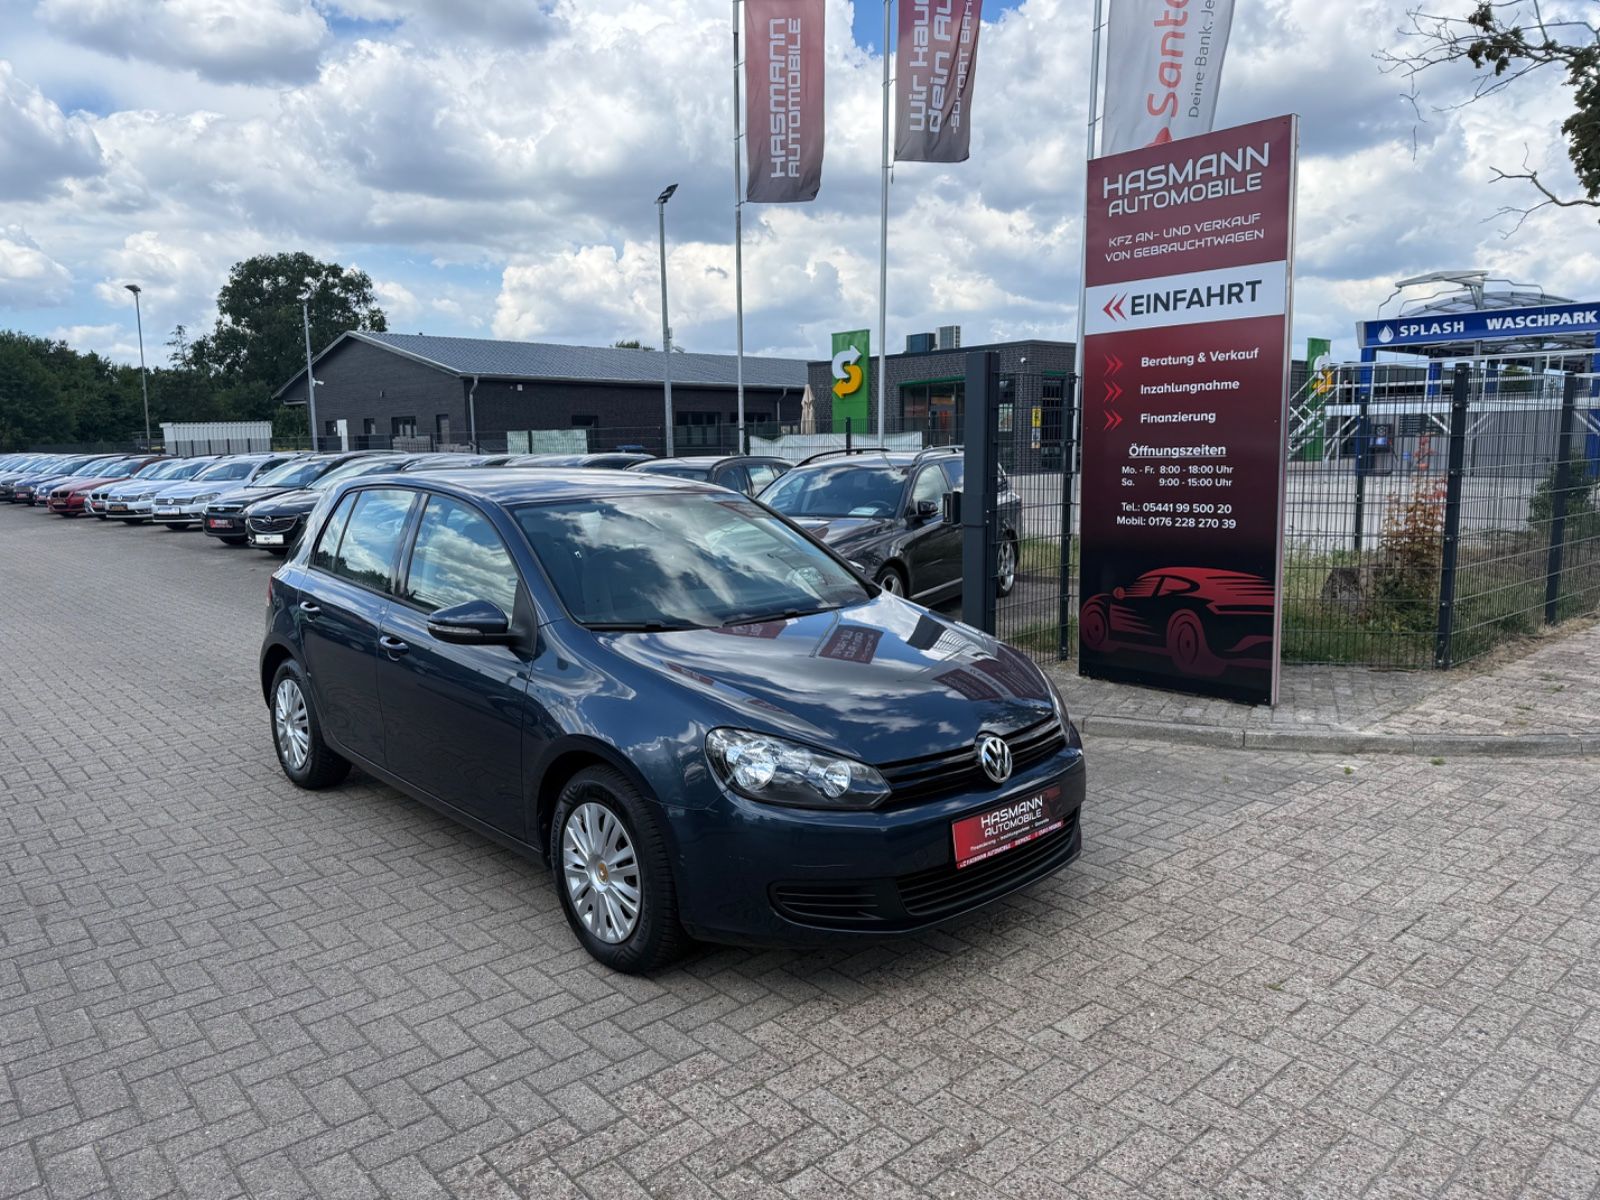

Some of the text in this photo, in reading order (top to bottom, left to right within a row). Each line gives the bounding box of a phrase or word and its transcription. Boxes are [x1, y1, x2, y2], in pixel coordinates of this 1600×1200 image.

[909, 0, 929, 67] kau
[1194, 21, 1213, 67] Bank.
[769, 18, 786, 178] HASMANN
[787, 18, 801, 178] AUTOMOBILE
[1188, 72, 1205, 118] Deine
[1103, 142, 1270, 199] HASMANN
[1108, 172, 1262, 217] AUTOMOBILE
[1105, 228, 1265, 263] VON GEBRAUCHTWAGEN
[1108, 212, 1262, 248] KFZ AN- UND VERKAUF
[1130, 279, 1263, 316] EINFAHRT
[1399, 310, 1598, 337] SPLASH WASCHPARK
[1141, 347, 1260, 368] Beratung & Verkauf
[1140, 379, 1240, 395] Inzahlungnahme
[1140, 411, 1217, 424] Finanzierung
[1128, 443, 1227, 459] Öffnungszeiten
[1121, 465, 1137, 475] Mo.
[1144, 465, 1155, 475] Fr.
[1159, 465, 1181, 475] 8:00
[1188, 465, 1214, 475] 18:00
[1216, 465, 1234, 475] Uhr
[1121, 477, 1135, 487] Sa.
[1159, 477, 1180, 487] 9:00
[1187, 477, 1213, 487] 15:00
[1215, 477, 1233, 487] Uhr
[1116, 516, 1237, 529] Mobil: 0176 228 270 39
[1121, 502, 1232, 514] Tel.: 05441 99 500 20
[980, 794, 1043, 829] HASMANN
[984, 808, 1042, 839] AUTOMOBILE
